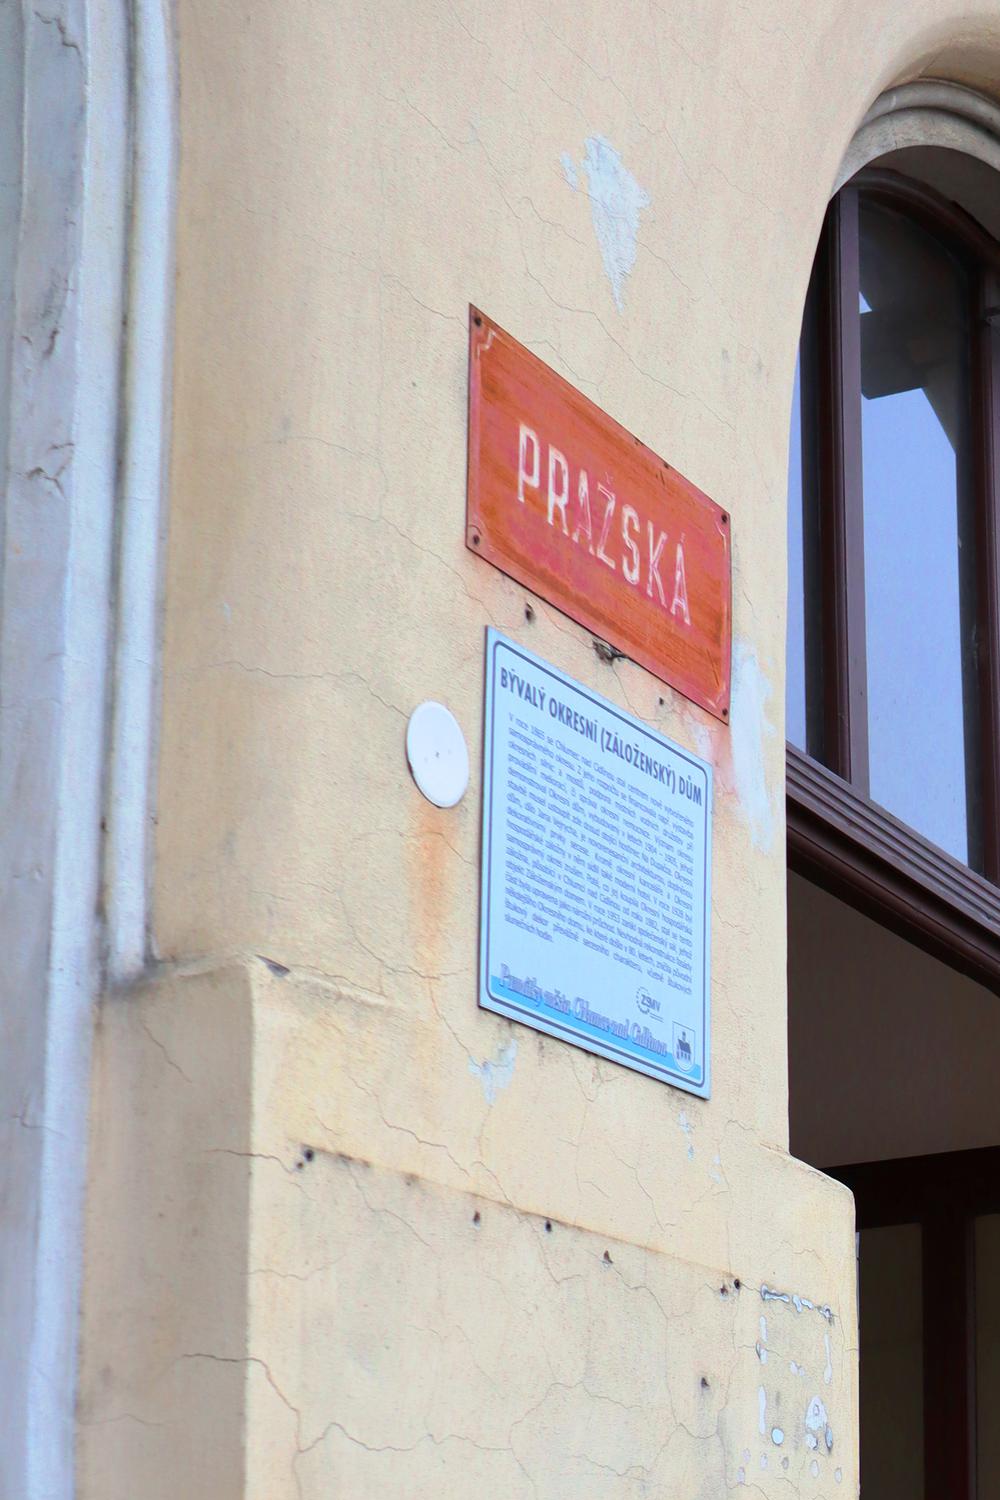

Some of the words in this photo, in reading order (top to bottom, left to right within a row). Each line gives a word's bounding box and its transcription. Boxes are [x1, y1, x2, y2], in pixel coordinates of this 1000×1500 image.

[517, 423, 691, 626] PRAŽSKÁ
[500, 667, 546, 711] BÝVALÝ
[549, 697, 598, 744] OKRESNÍ
[600, 727, 676, 795] (ZÁLOŽENSKÝ)
[678, 774, 702, 807] DŮM
